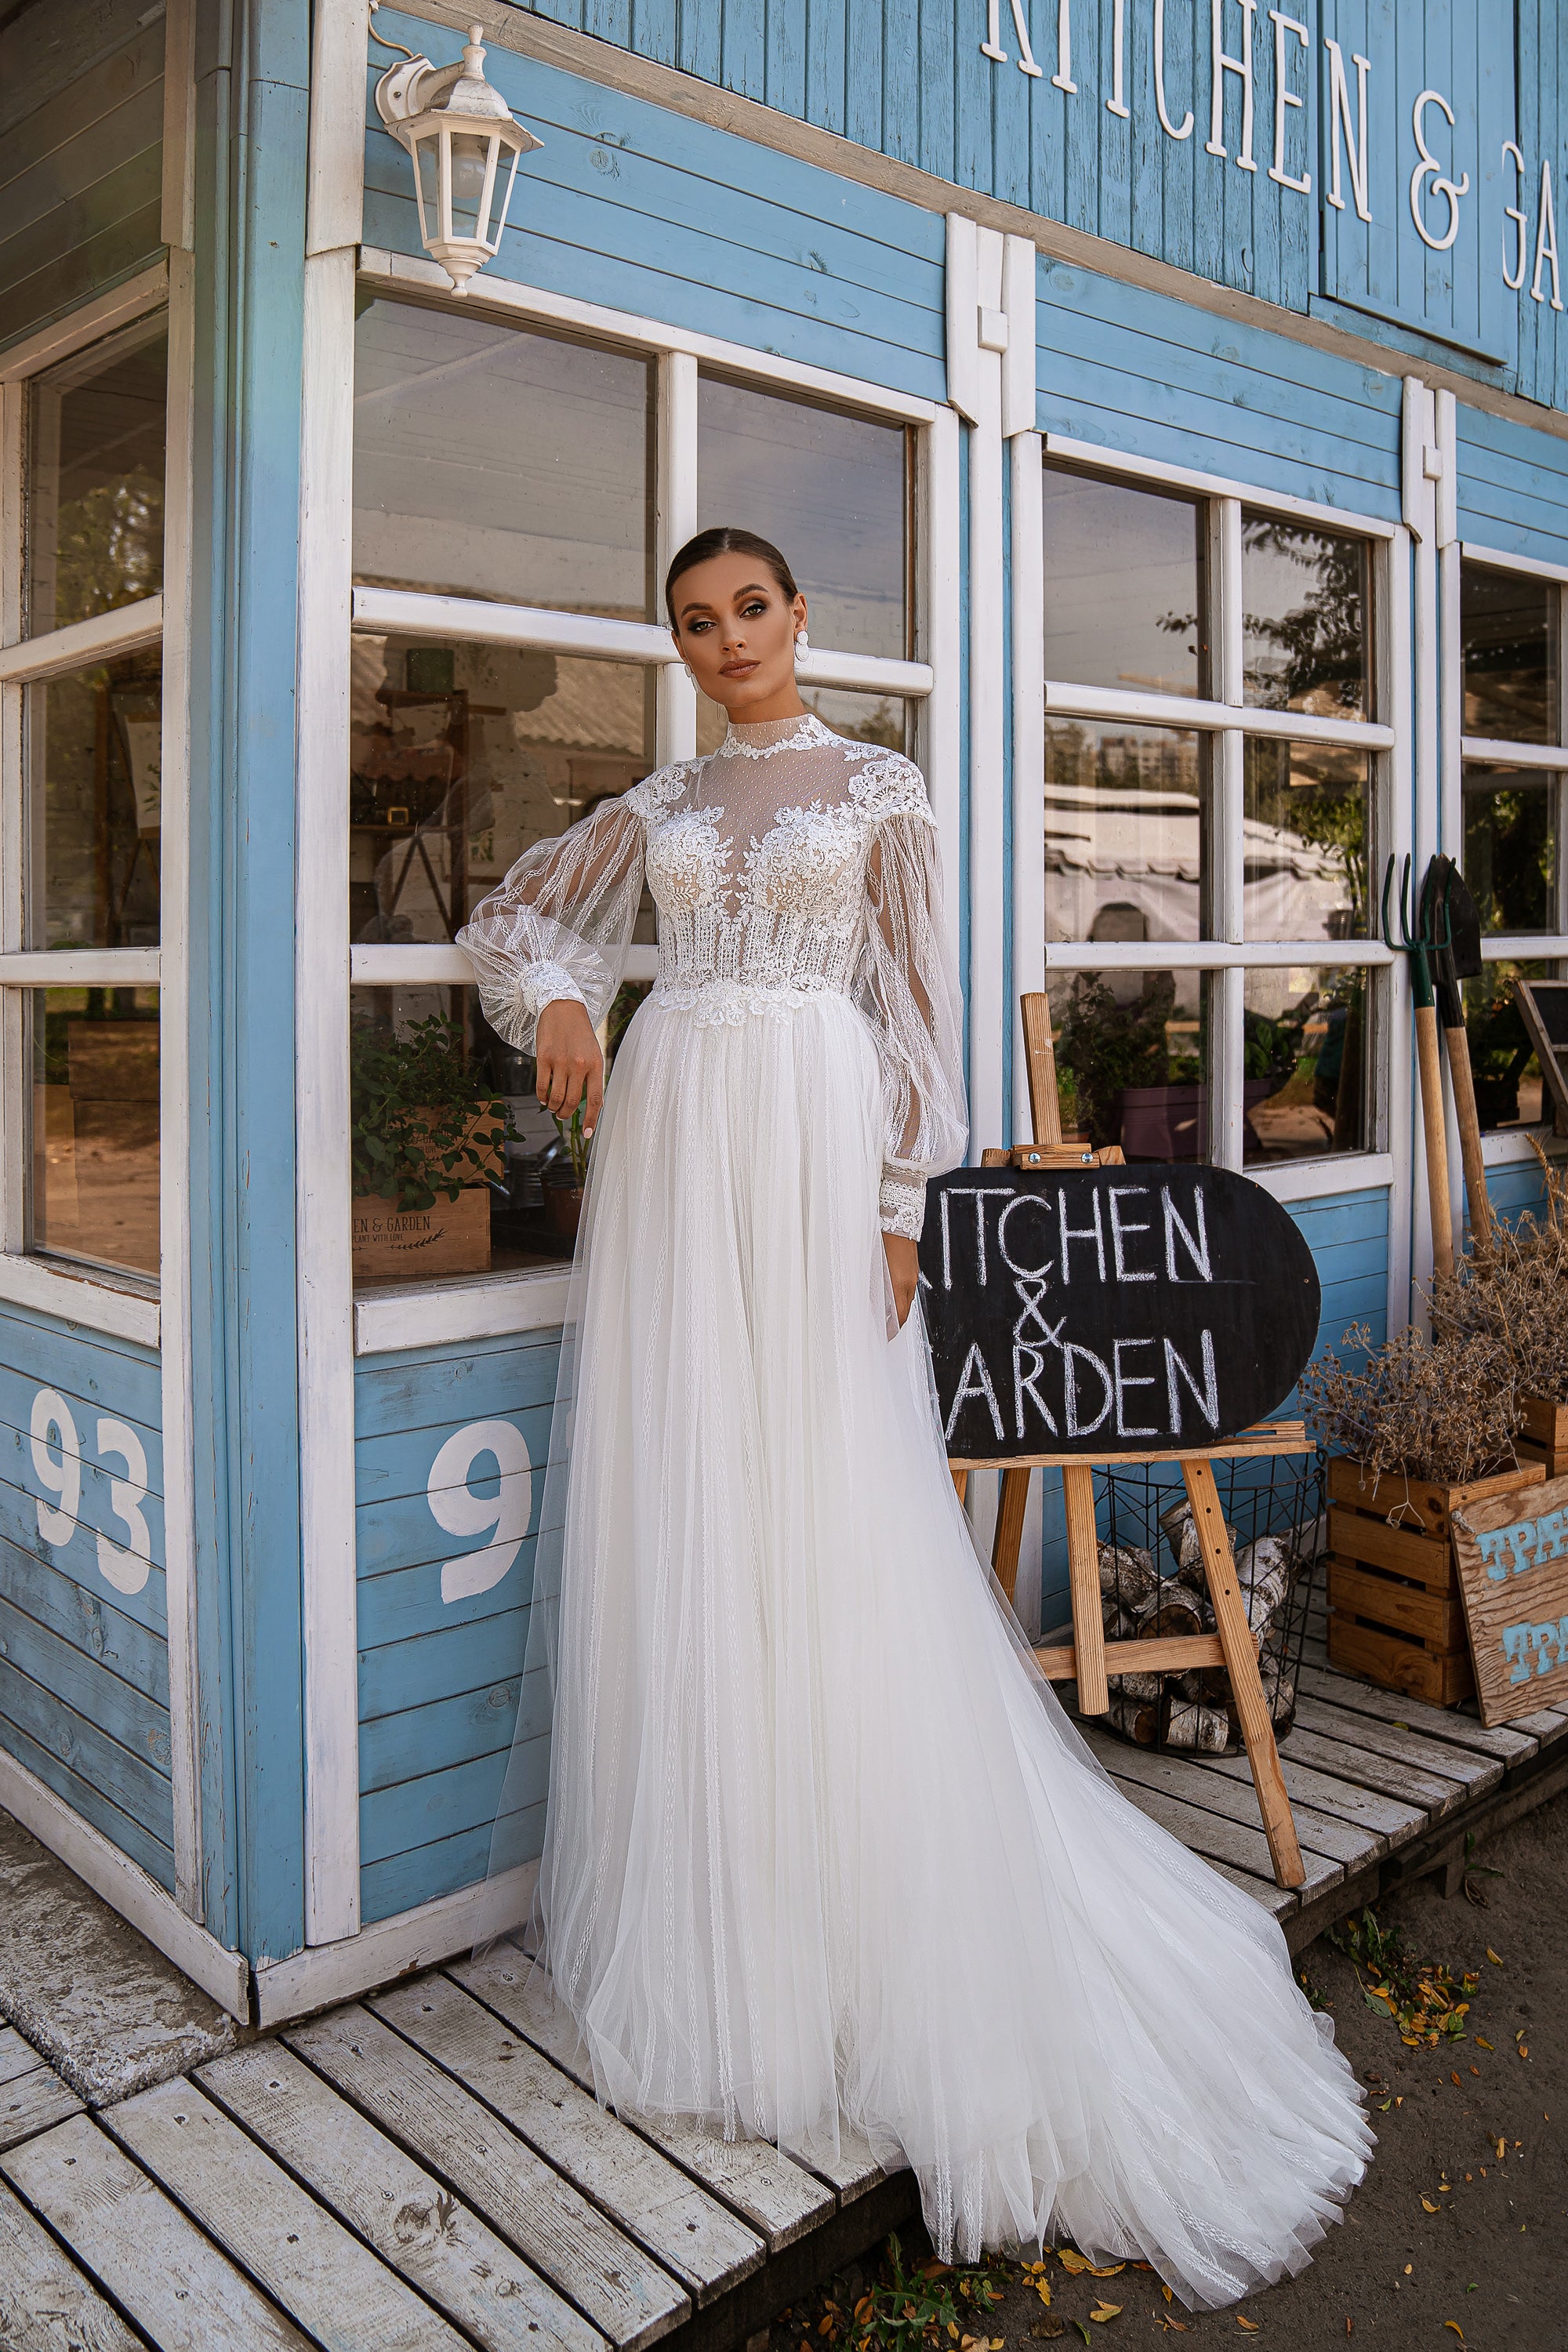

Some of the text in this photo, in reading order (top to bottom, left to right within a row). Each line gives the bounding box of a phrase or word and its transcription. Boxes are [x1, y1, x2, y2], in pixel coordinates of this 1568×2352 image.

[1410, 89, 1470, 251] &
[353, 1215, 430, 1233] EN & GARDEN
[372, 1234, 388, 1243] WITH
[389, 1233, 405, 1242] LOVE
[918, 1185, 1213, 1291] ITCHEN
[1013, 1278, 1067, 1348] &
[931, 1330, 1220, 1441] ARDEN
[30, 1388, 151, 1595] 93
[427, 1409, 573, 1605] 9
